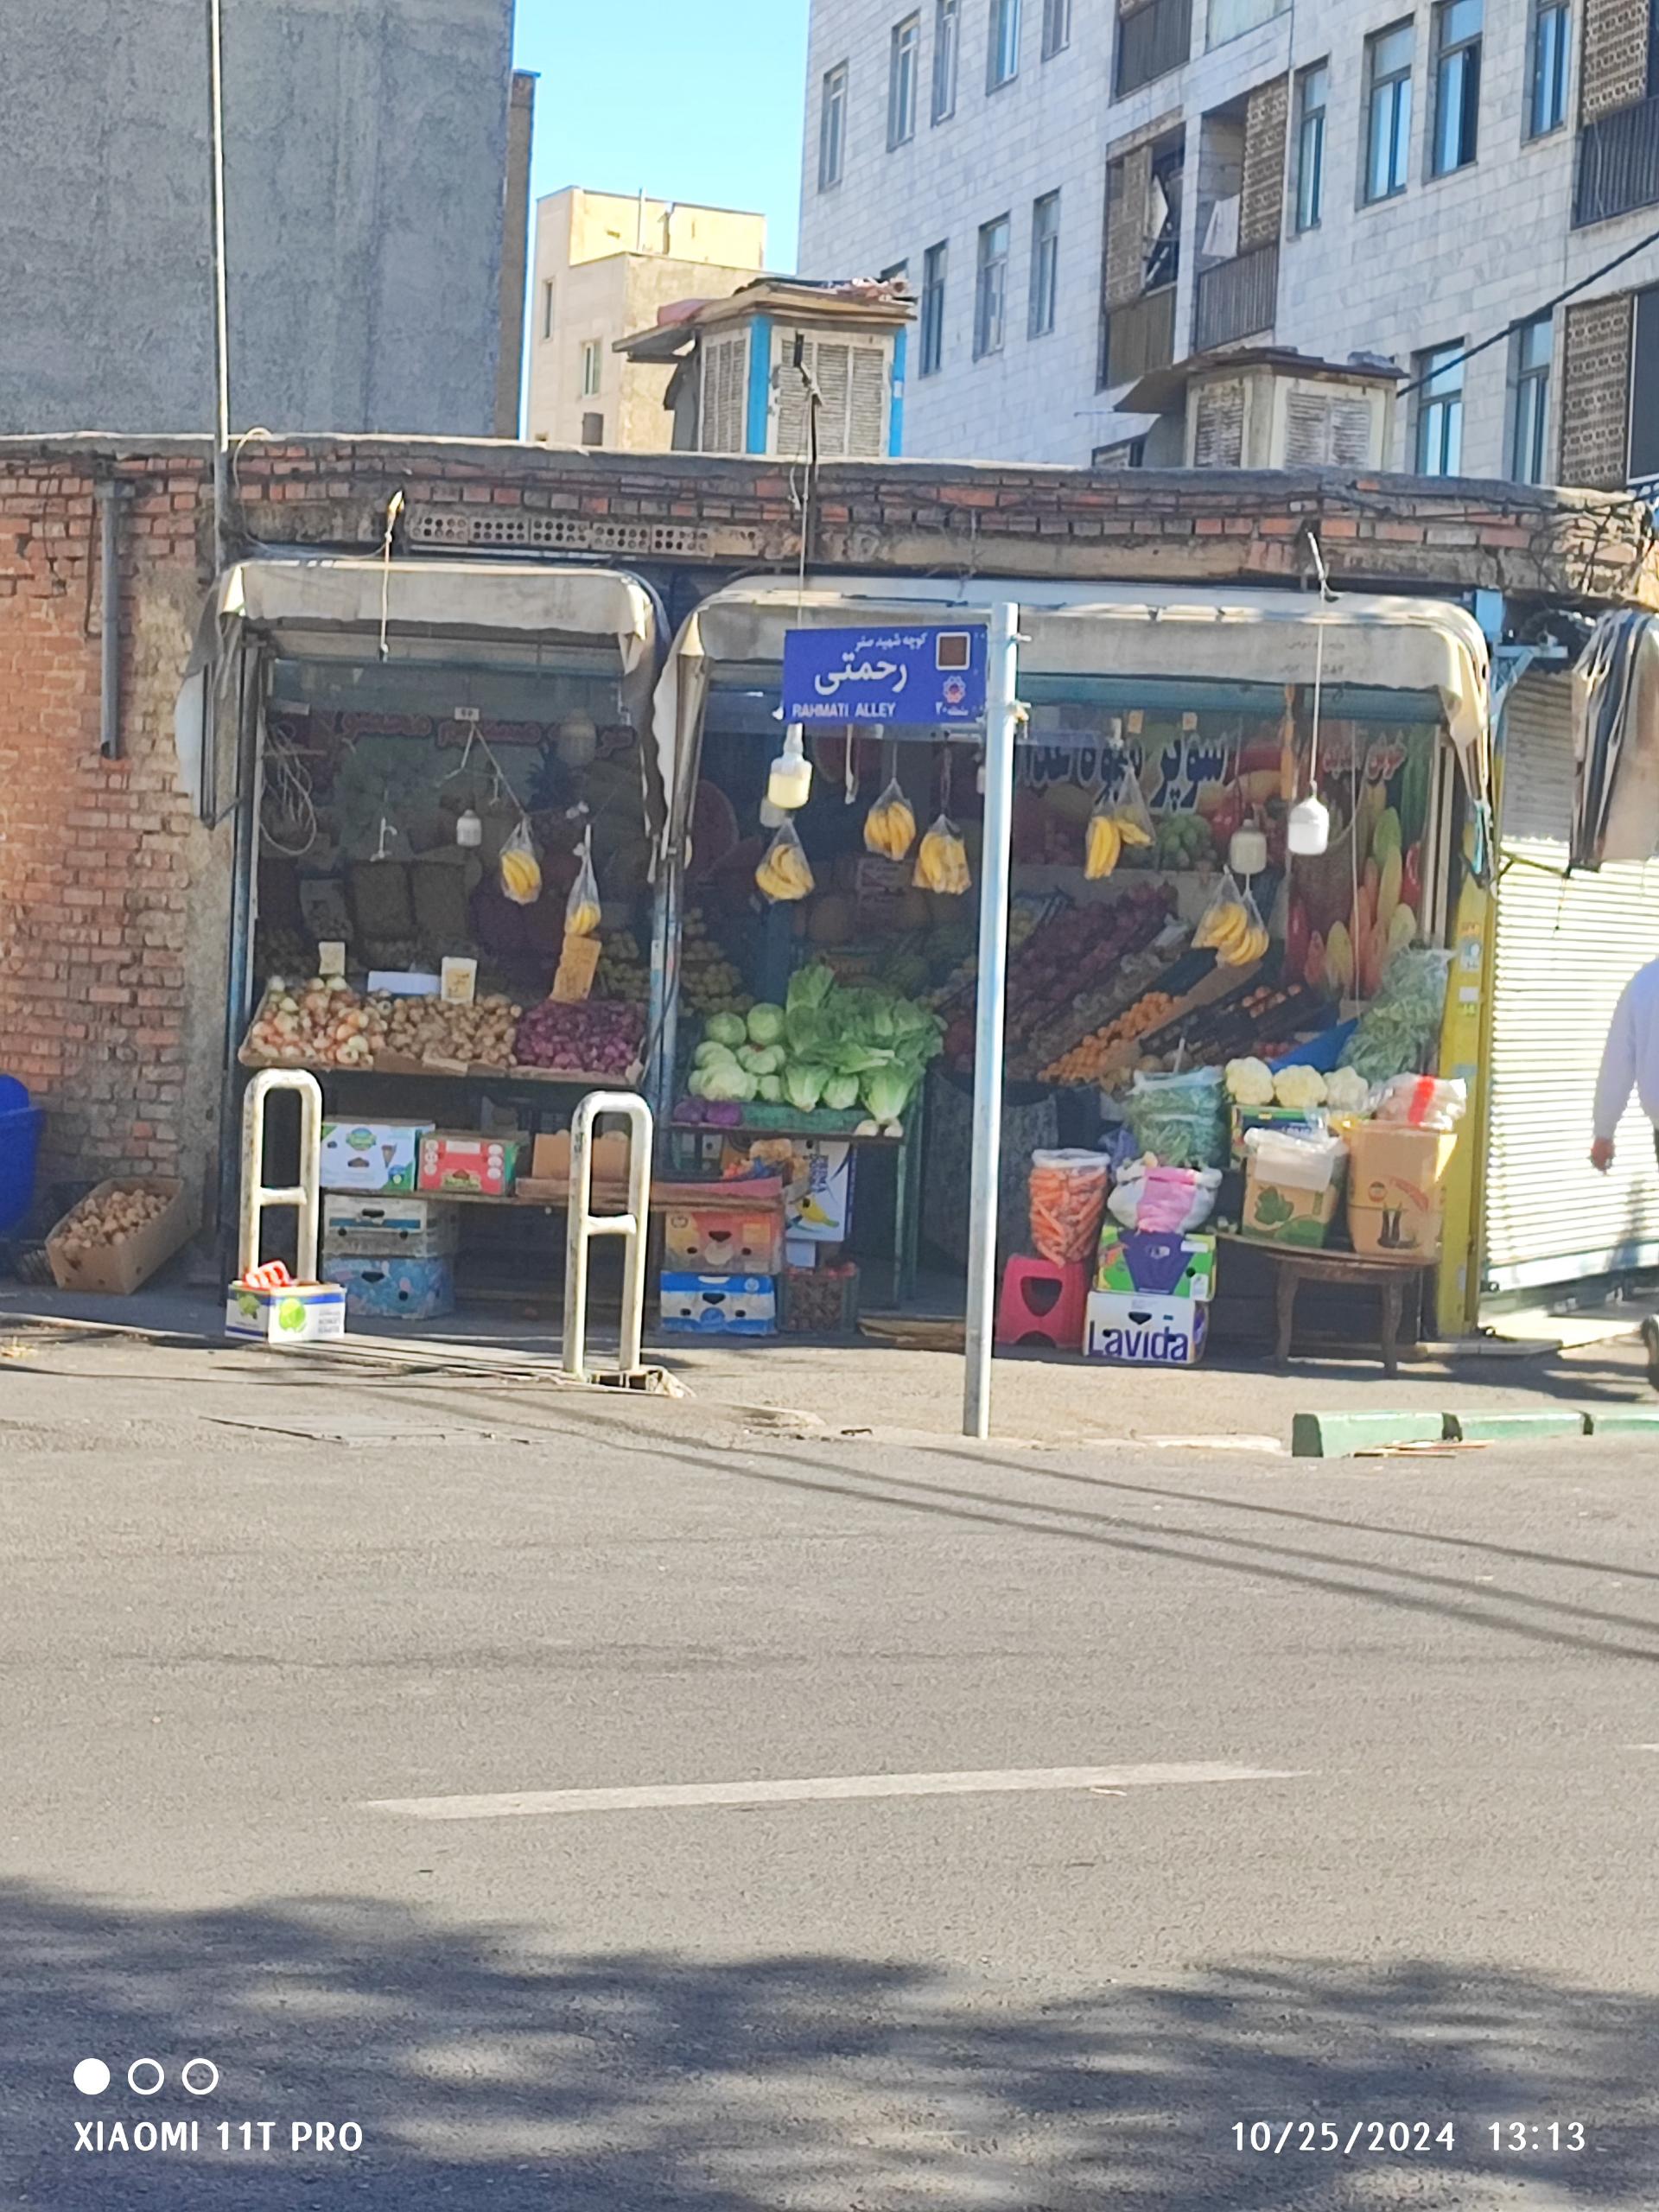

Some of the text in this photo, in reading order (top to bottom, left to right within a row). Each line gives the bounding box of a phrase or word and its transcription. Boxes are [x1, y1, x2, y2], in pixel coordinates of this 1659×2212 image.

[875, 632, 901, 650] شهید
[903, 632, 928, 650] کوچه
[814, 652, 908, 696] رحمتی
[791, 702, 897, 718] RAHMATI ALLEY
[1089, 1319, 1188, 1361] Lavida
